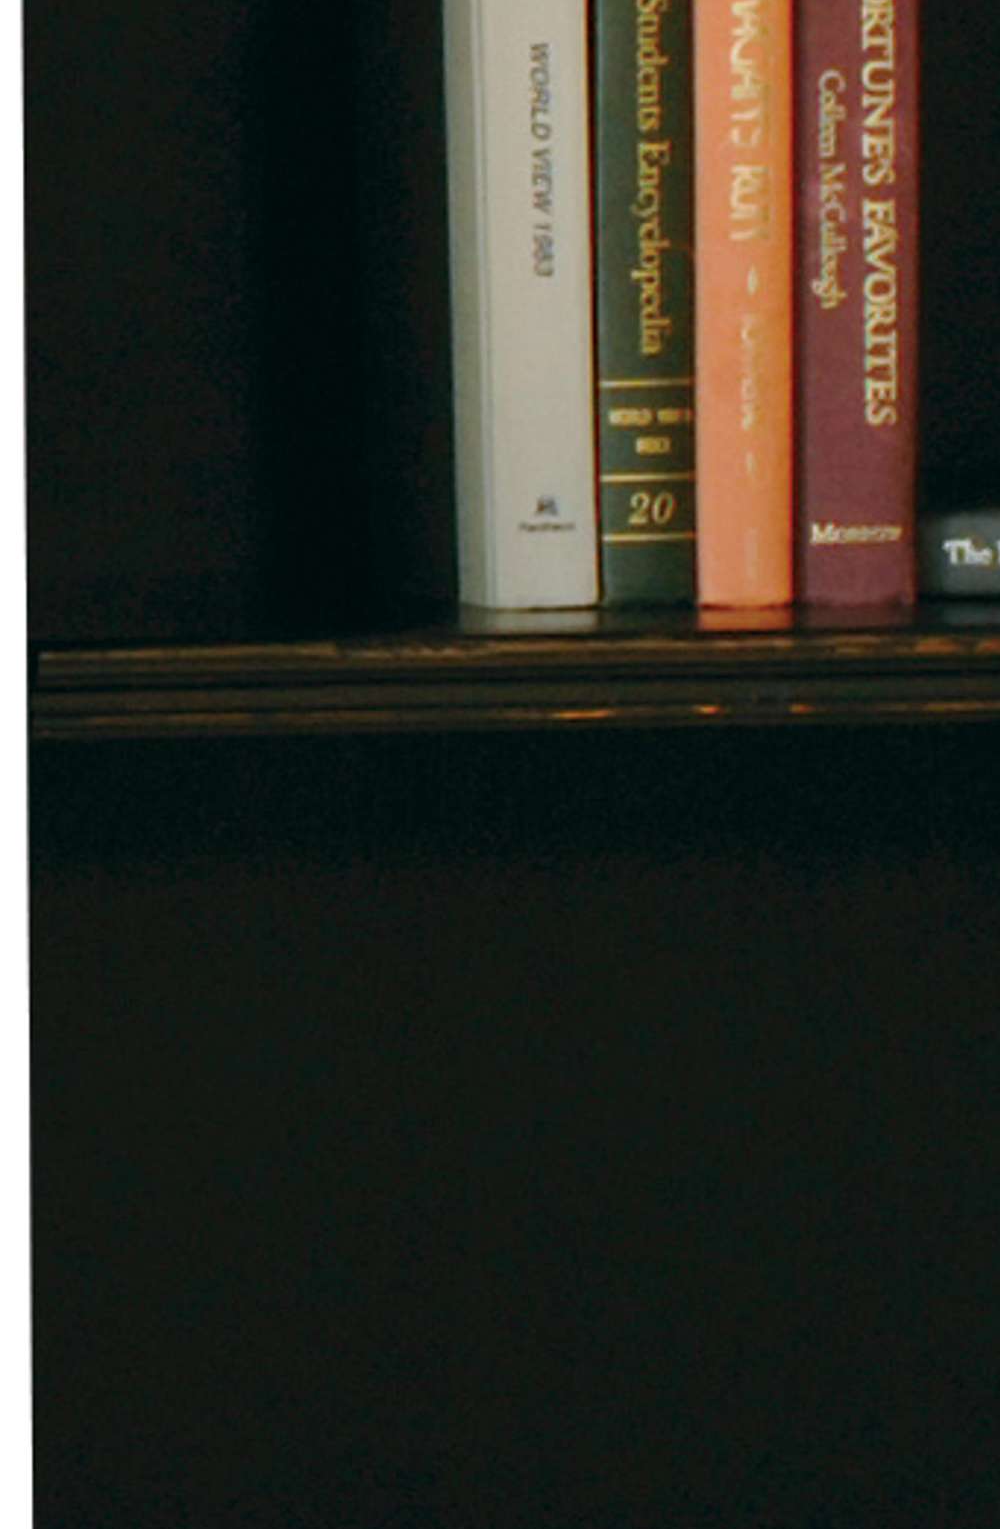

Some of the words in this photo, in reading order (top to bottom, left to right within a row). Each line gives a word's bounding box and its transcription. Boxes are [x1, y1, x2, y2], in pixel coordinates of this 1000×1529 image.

[530, 42, 551, 142] WORLD
[531, 148, 553, 214] VIEW
[630, 141, 673, 356] Encyclopedia
[862, 198, 897, 427] FAVORITES
[627, 492, 677, 526] 20
[943, 539, 993, 566] The
